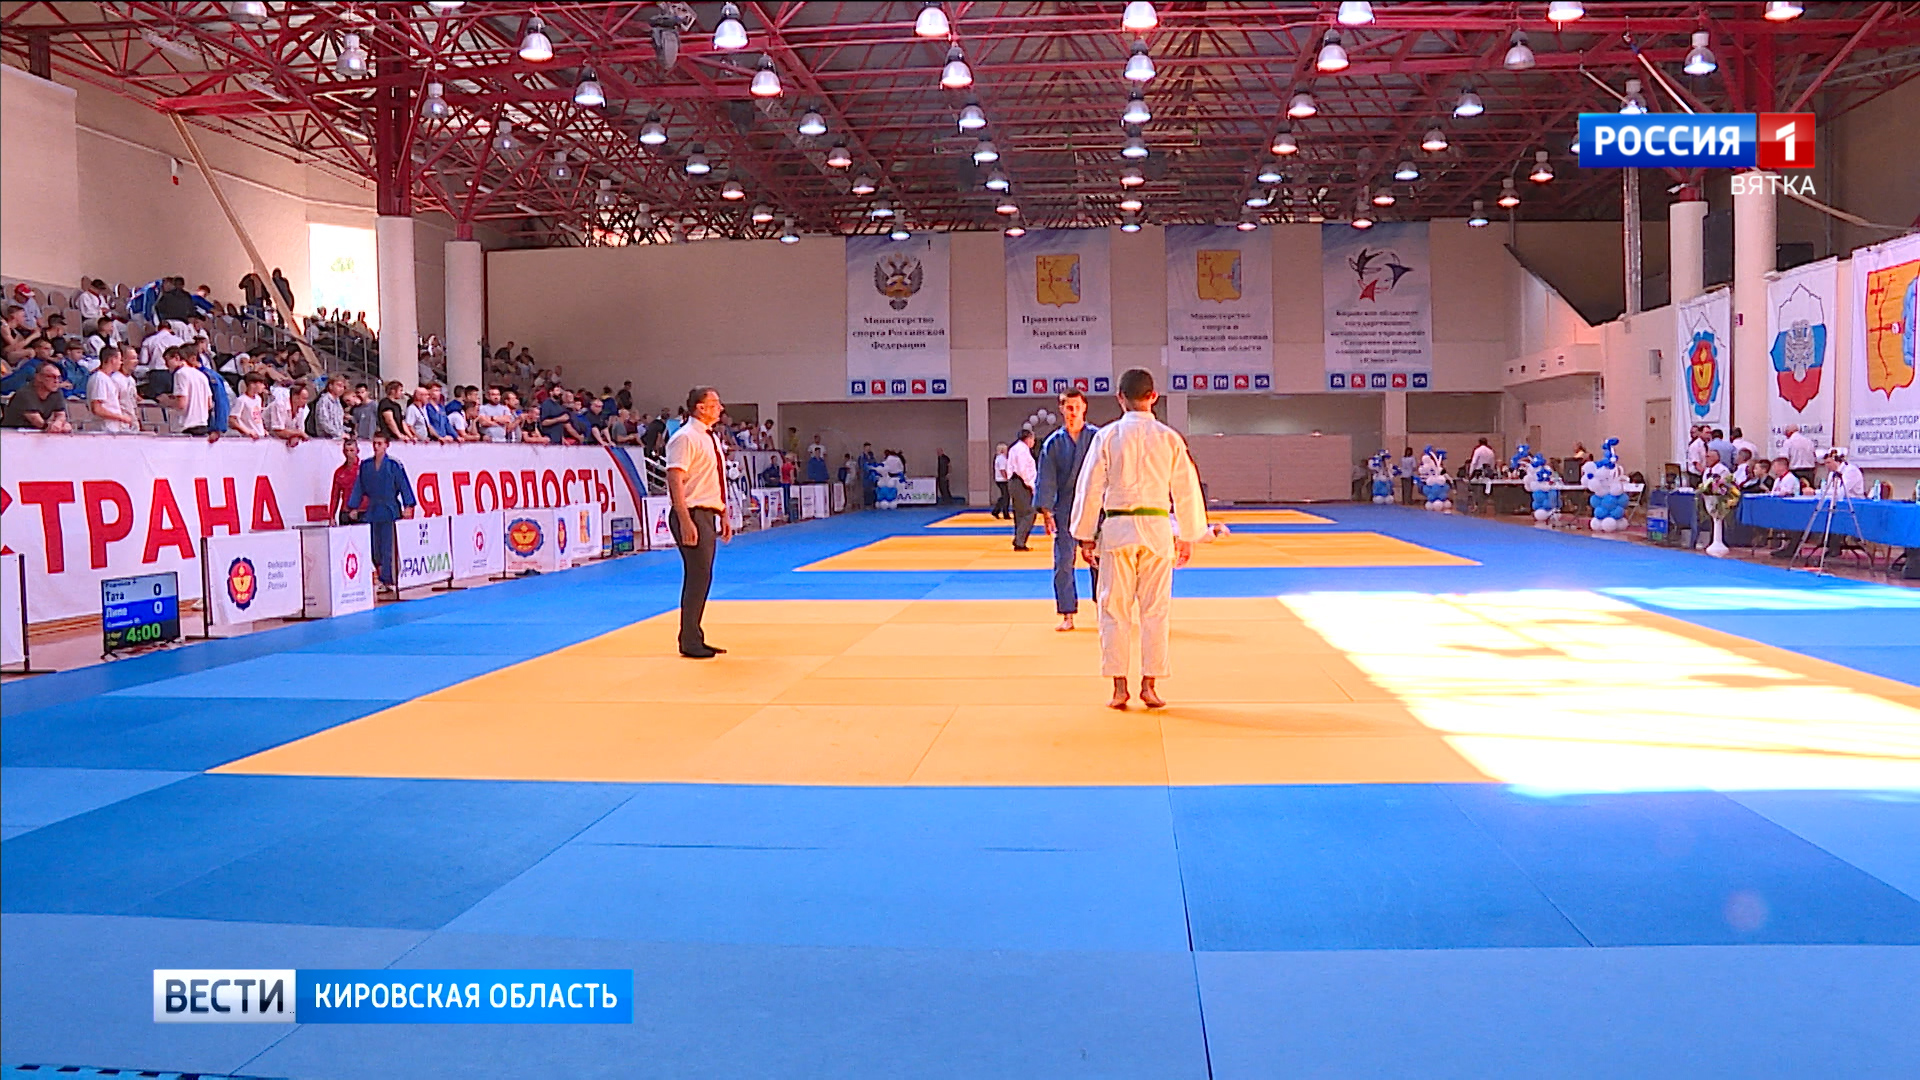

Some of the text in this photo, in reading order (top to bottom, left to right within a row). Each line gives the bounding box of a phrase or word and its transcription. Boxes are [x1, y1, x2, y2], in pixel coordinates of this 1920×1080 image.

[863, 317, 935, 325] Министерство
[0, 475, 285, 574] ТРАНА
[153, 583, 162, 596] 0
[153, 601, 163, 614] 0
[126, 623, 161, 642] 4:00
